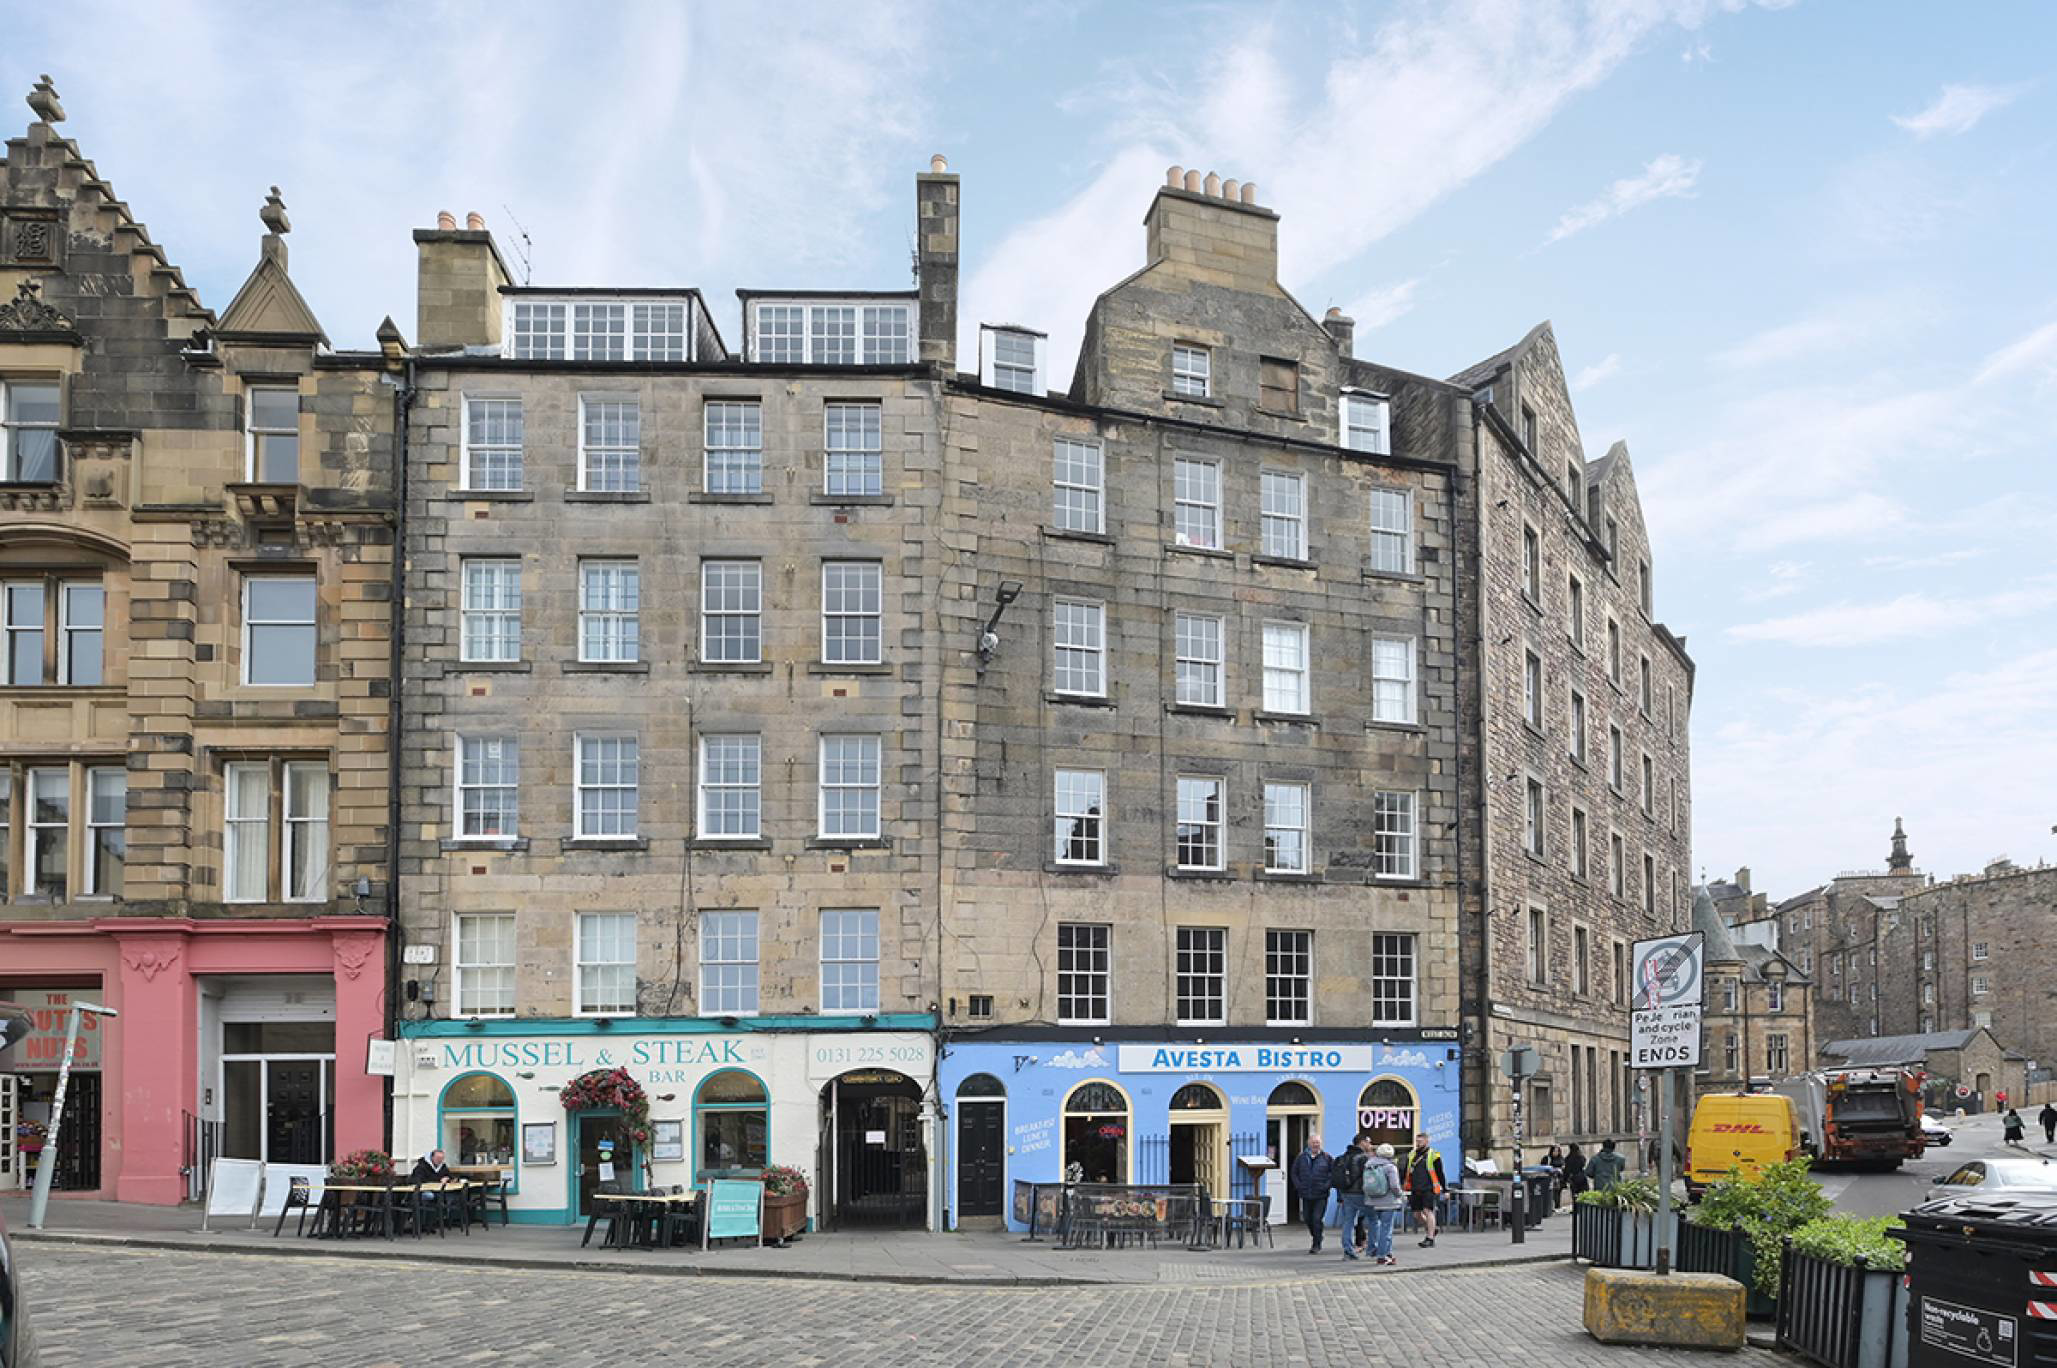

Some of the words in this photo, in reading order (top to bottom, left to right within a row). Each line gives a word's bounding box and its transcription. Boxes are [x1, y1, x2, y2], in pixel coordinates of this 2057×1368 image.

[46, 994, 68, 1005] THE
[1638, 1024, 1659, 1034] and
[1661, 1021, 1691, 1034] cycle
[1650, 1034, 1679, 1045] Zone
[442, 1041, 584, 1068] MUSSEL
[595, 1049, 614, 1065] &
[632, 1039, 748, 1065] STEAK
[816, 1048, 852, 1062] 0131
[857, 1047, 884, 1061] 225
[889, 1046, 924, 1061] 5028
[1152, 1048, 1241, 1067] AVESTA
[1257, 1048, 1342, 1067] BISTRO
[1639, 1045, 1690, 1062] ENDS
[649, 1070, 686, 1083] BAR
[1360, 1109, 1411, 1129] OPEN
[1711, 1123, 1765, 1134] DHL
